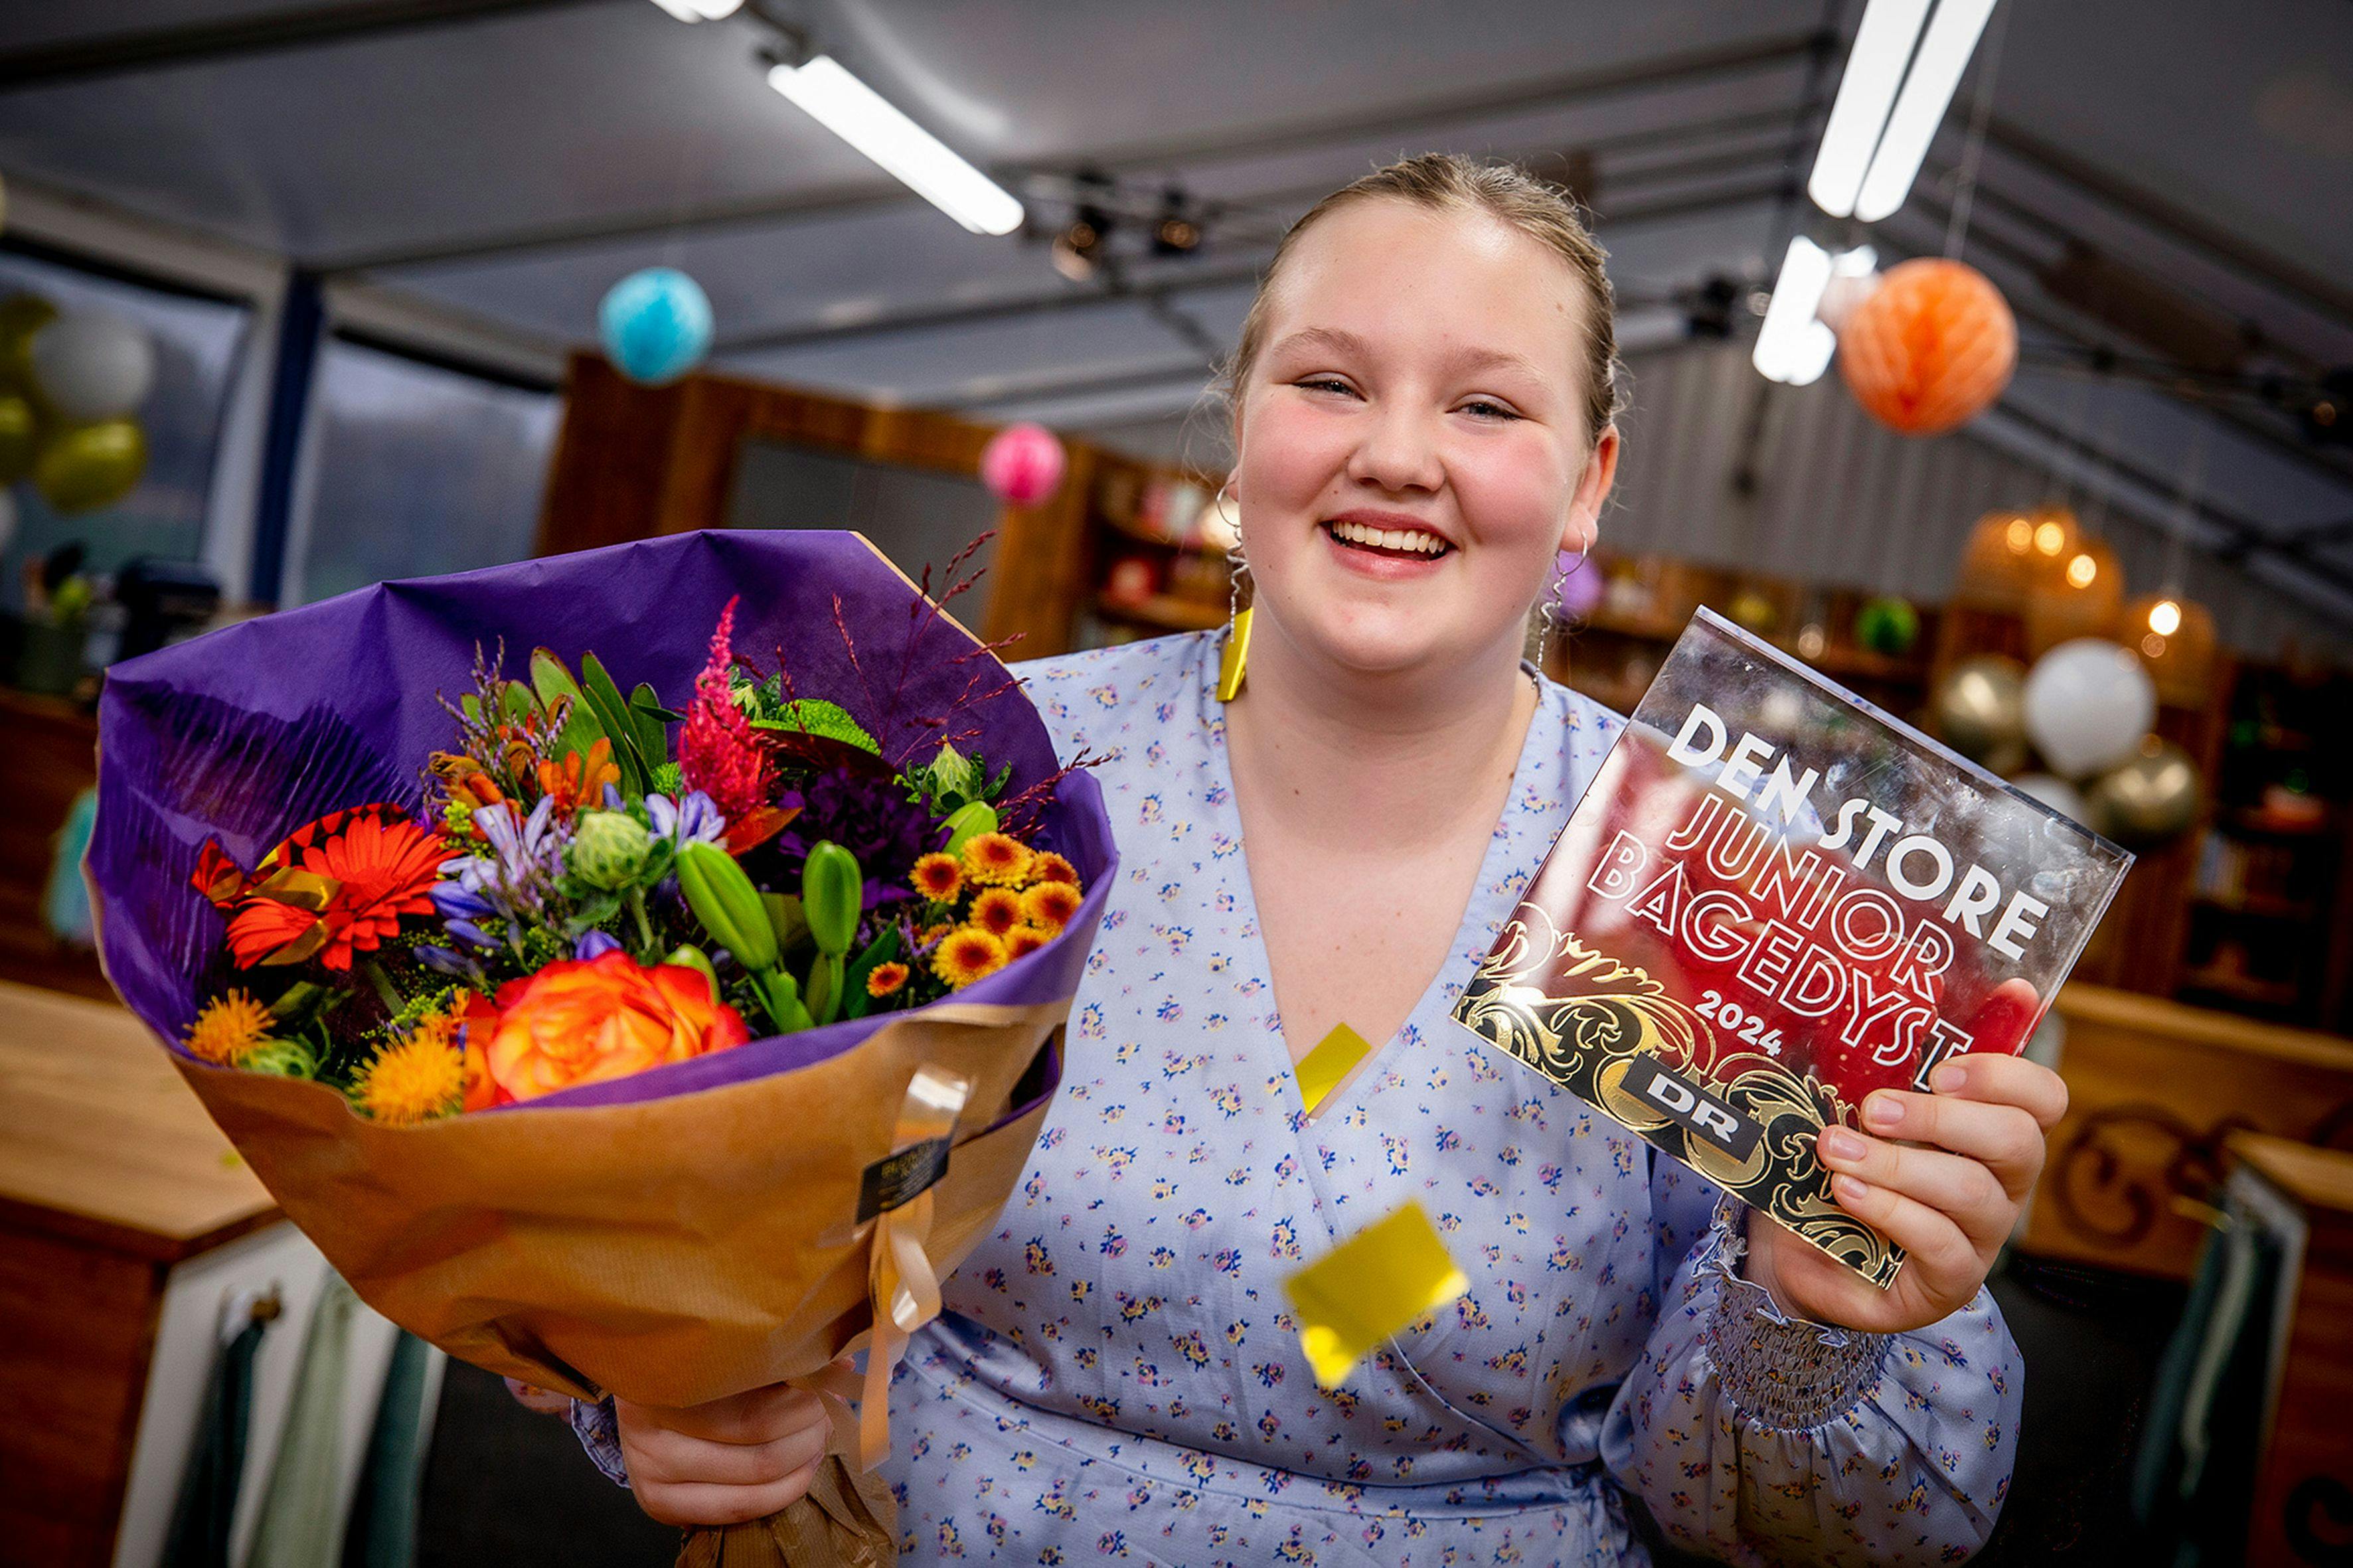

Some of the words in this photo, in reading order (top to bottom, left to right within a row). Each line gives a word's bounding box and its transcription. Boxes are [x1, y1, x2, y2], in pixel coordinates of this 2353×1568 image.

[1666, 703, 1820, 826] DEN
[1818, 799, 2048, 961] STORE
[1666, 793, 1955, 1002] JUNIOR
[1587, 830, 1974, 1092] BAGEDYST
[1694, 990, 1785, 1056] 2024
[1647, 1073, 1740, 1143] DR
